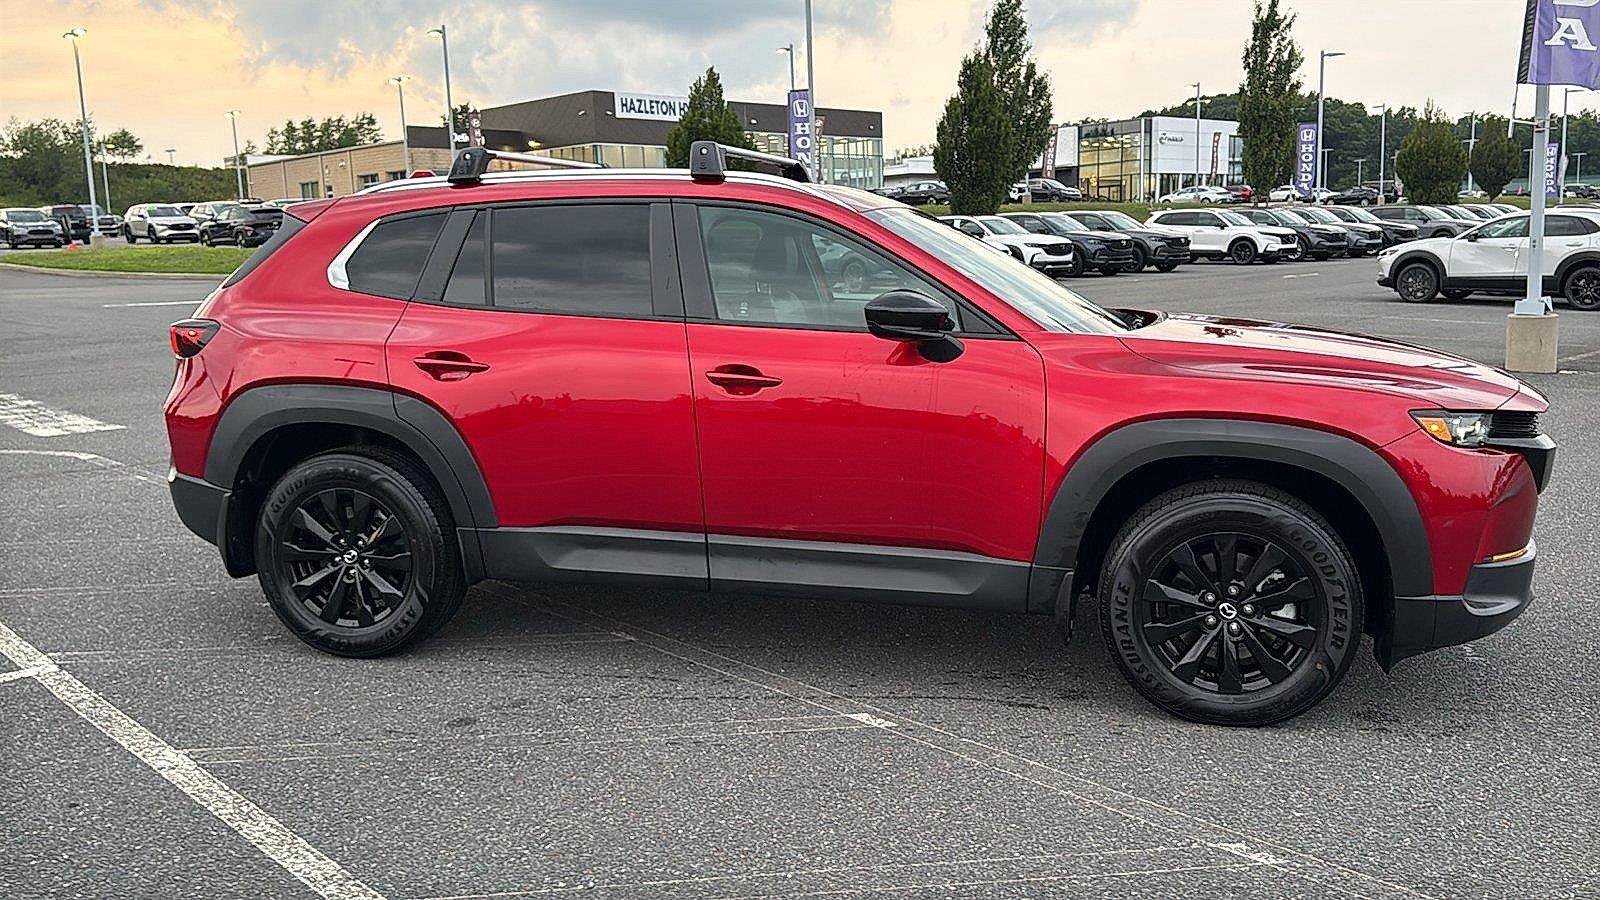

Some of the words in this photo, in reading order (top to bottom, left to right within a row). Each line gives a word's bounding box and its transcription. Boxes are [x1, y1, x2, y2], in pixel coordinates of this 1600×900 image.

[1544, 0, 1600, 51] A
[620, 97, 677, 116] HAZLETON
[794, 122, 812, 164] HON
[1299, 143, 1314, 191] HONDA
[1545, 157, 1556, 193] HONDA
